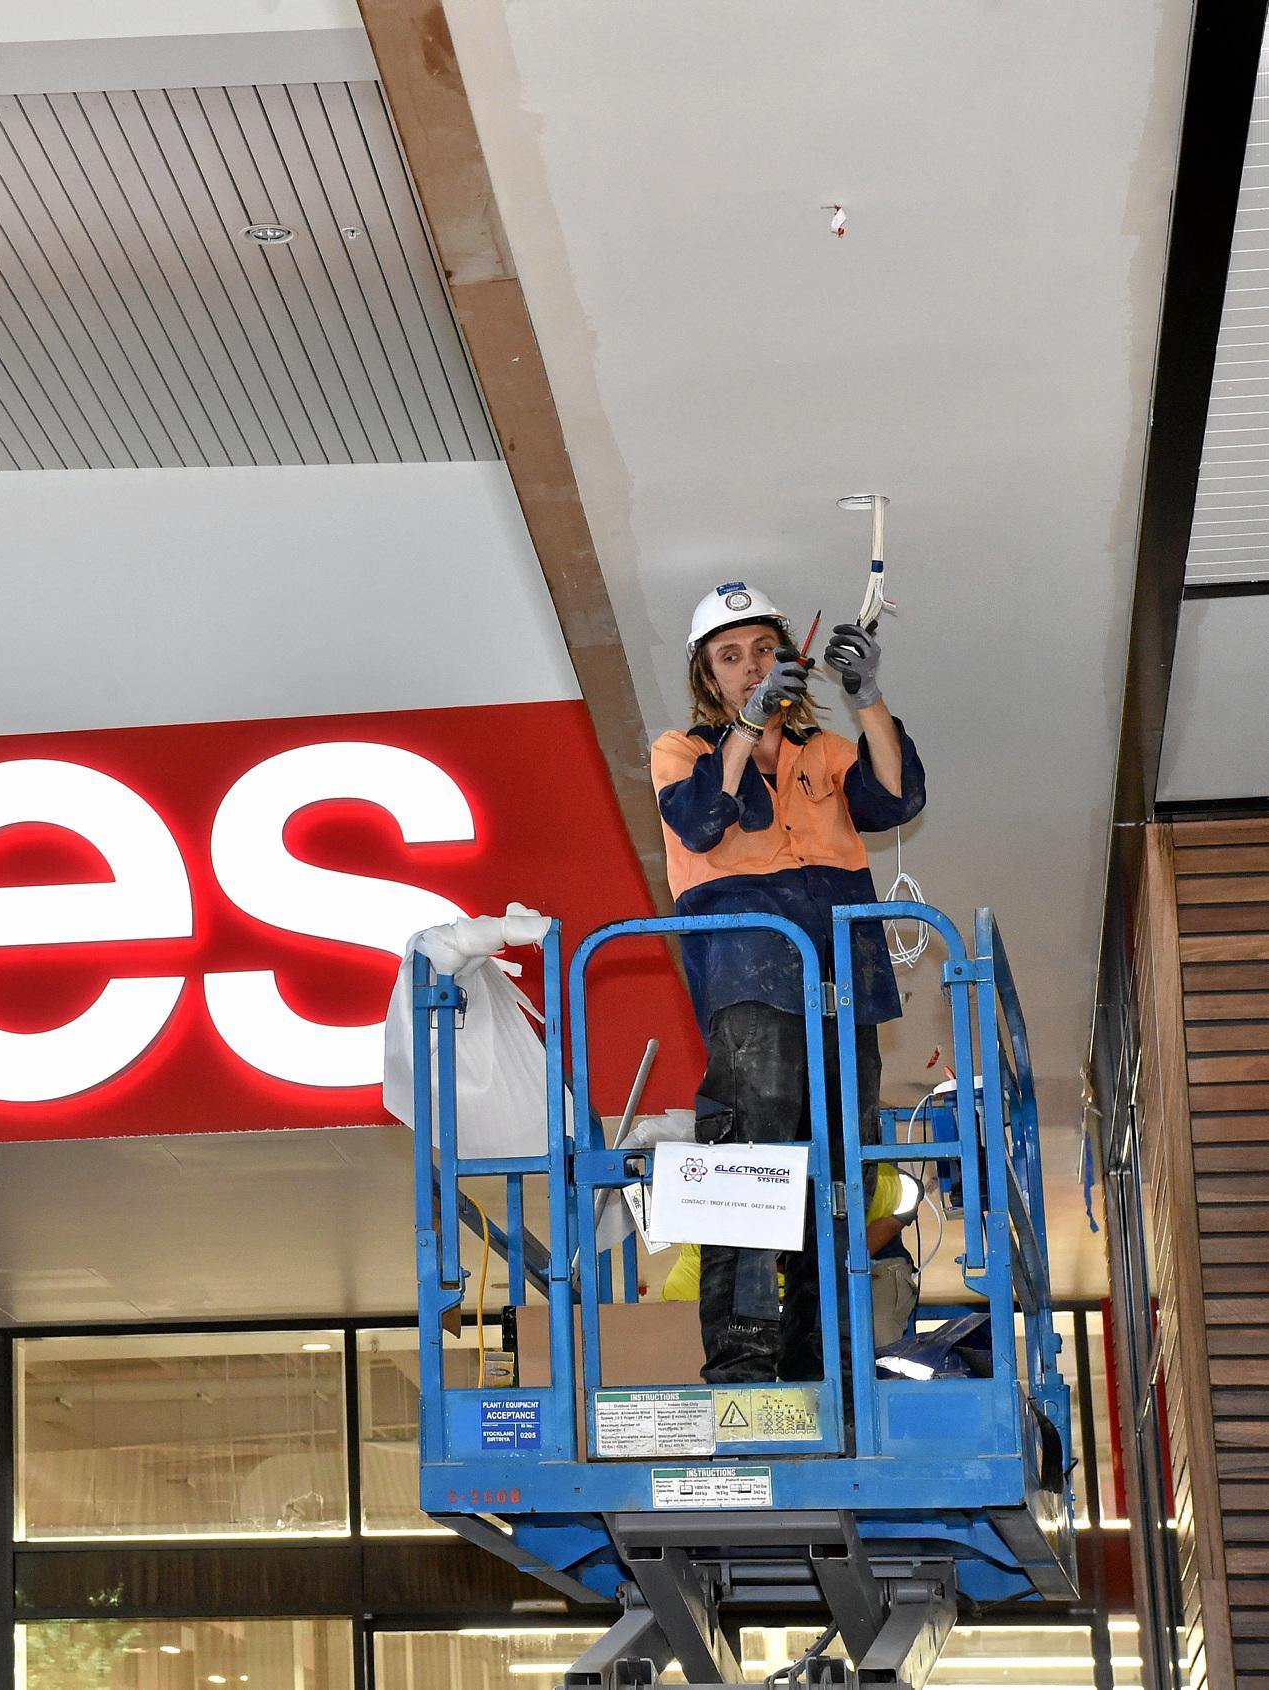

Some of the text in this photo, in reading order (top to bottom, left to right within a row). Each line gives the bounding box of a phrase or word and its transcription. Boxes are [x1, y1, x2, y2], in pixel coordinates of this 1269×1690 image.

[715, 1164, 790, 1176] ELECTROTECH
[757, 1176, 789, 1184] SYSTEMS
[630, 1392, 680, 1401] INSTRUCTIONS
[482, 1401, 501, 1409] PLANT
[506, 1401, 539, 1409] EQUIPMENT
[486, 1411, 536, 1420] ACCEPTANCE
[686, 1469, 736, 1478] INSTRUCTIONS
